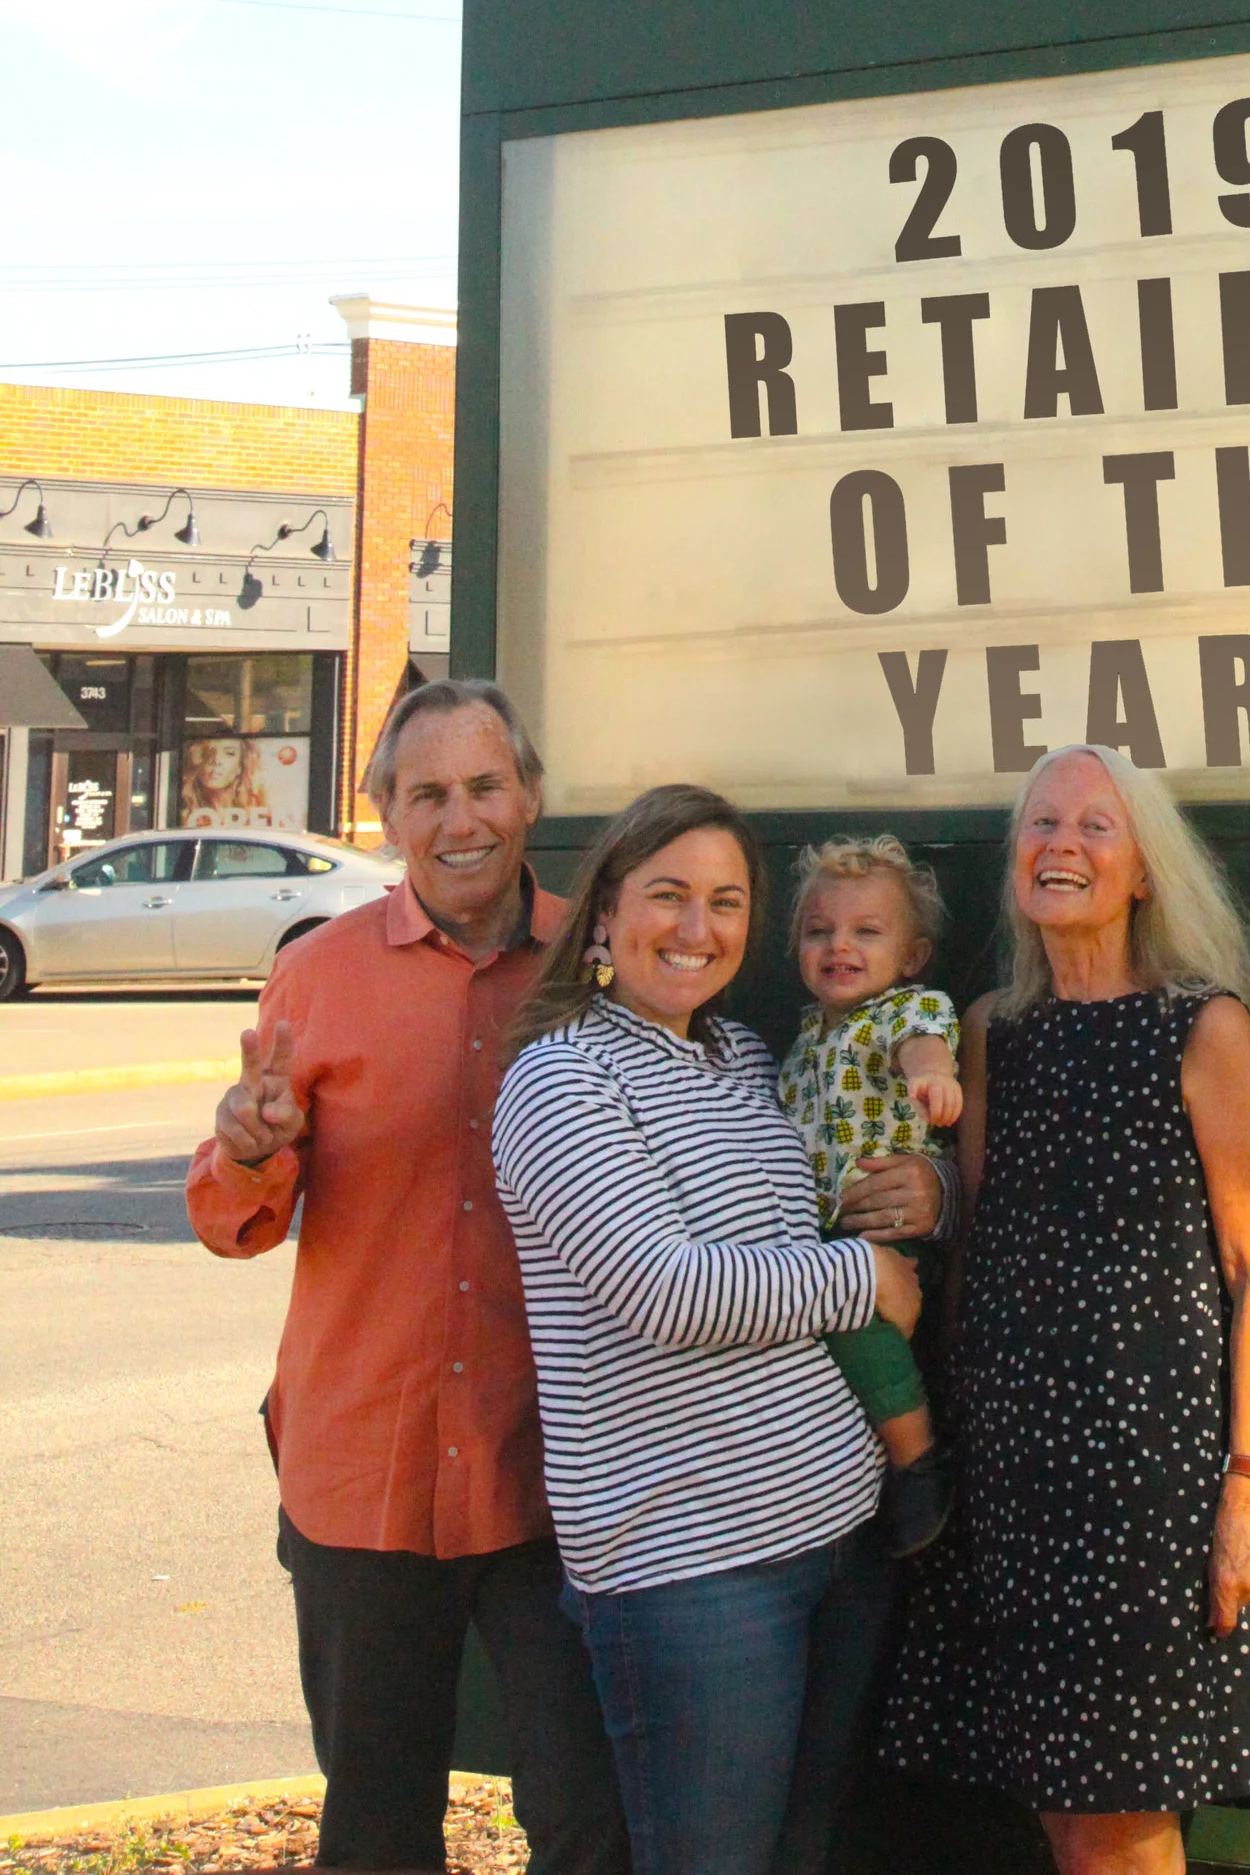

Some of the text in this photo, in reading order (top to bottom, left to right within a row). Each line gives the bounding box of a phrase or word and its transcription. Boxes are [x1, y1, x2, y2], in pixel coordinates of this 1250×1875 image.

[828, 462, 1007, 615] OF
[137, 607, 231, 627] SALON & SPA
